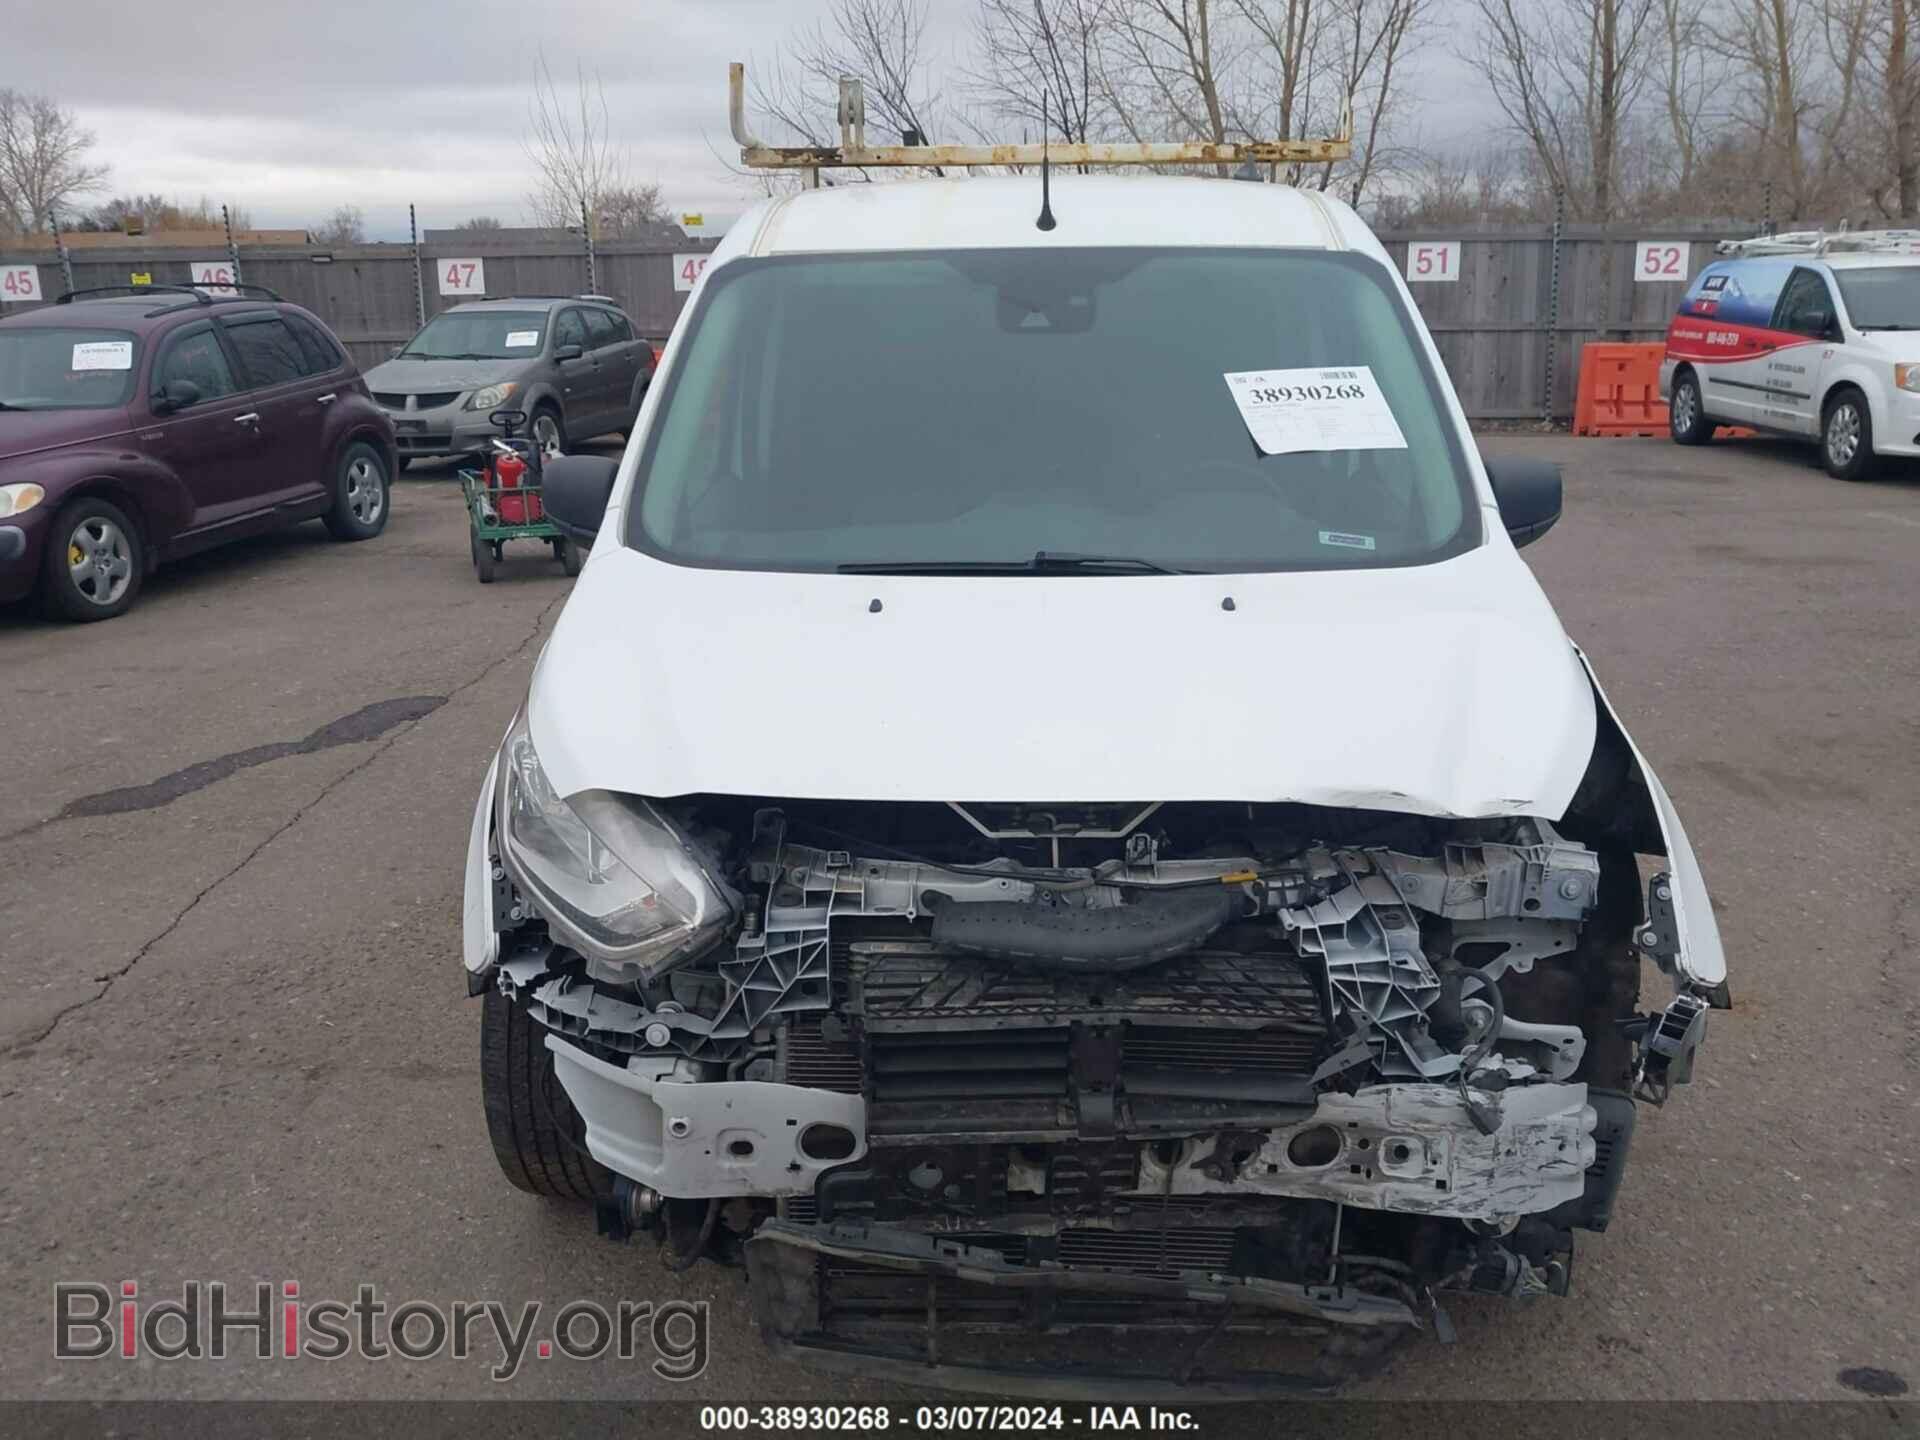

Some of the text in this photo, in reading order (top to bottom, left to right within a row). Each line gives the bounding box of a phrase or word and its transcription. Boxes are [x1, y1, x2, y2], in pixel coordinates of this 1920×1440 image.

[1416, 247, 1450, 275] 51
[1644, 247, 1680, 274] 52
[4, 271, 33, 295] 45
[200, 269, 232, 293] 46
[447, 263, 476, 288] 47
[1249, 383, 1365, 405] 38930268
